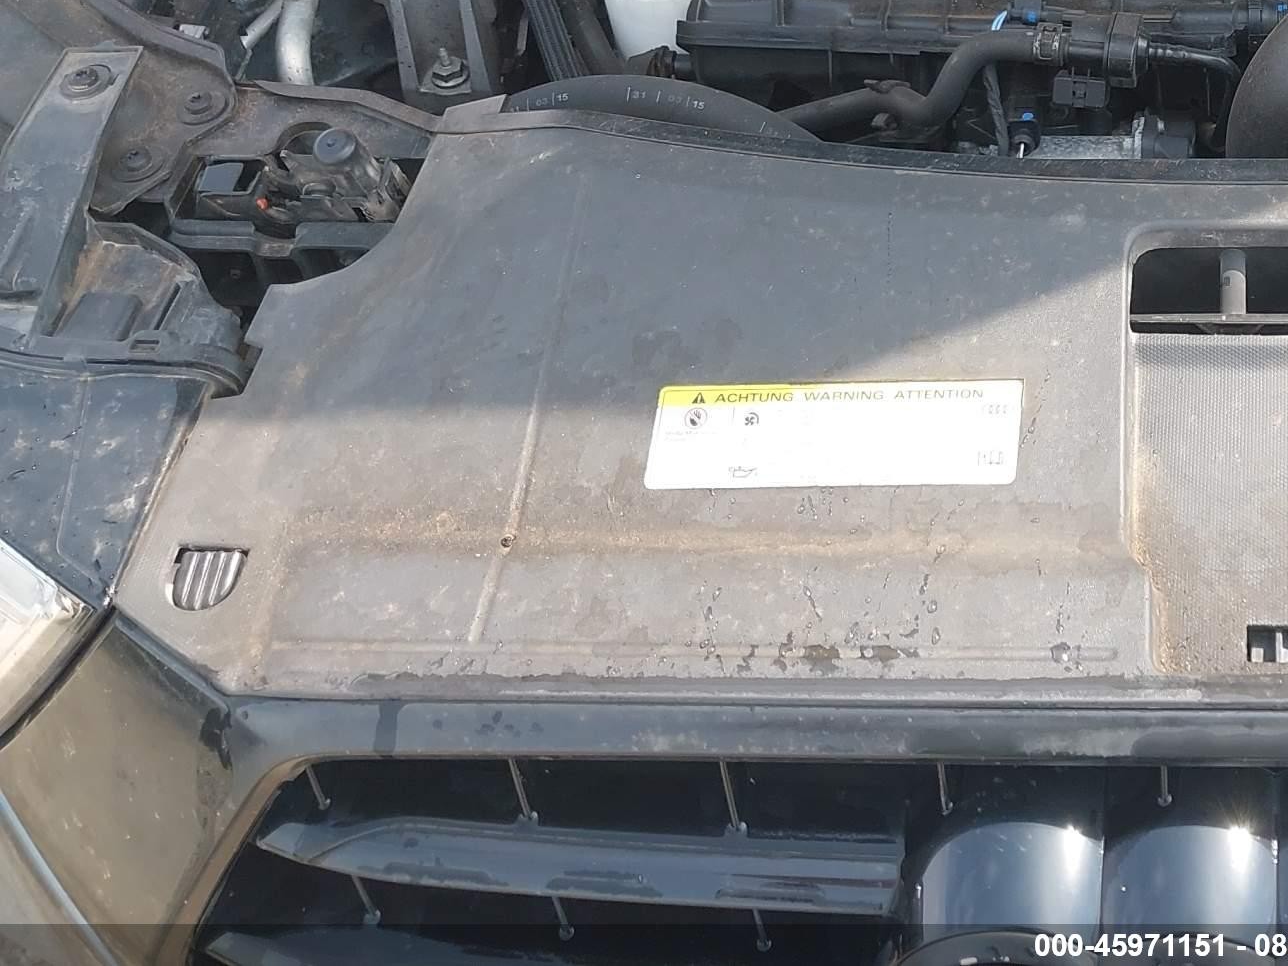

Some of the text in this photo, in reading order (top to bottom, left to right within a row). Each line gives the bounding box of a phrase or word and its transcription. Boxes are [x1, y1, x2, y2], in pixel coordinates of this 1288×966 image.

[556, 93, 569, 102] 15
[692, 100, 705, 110] 15
[714, 388, 984, 403] ACHTUNG WARNING ATTENTION
